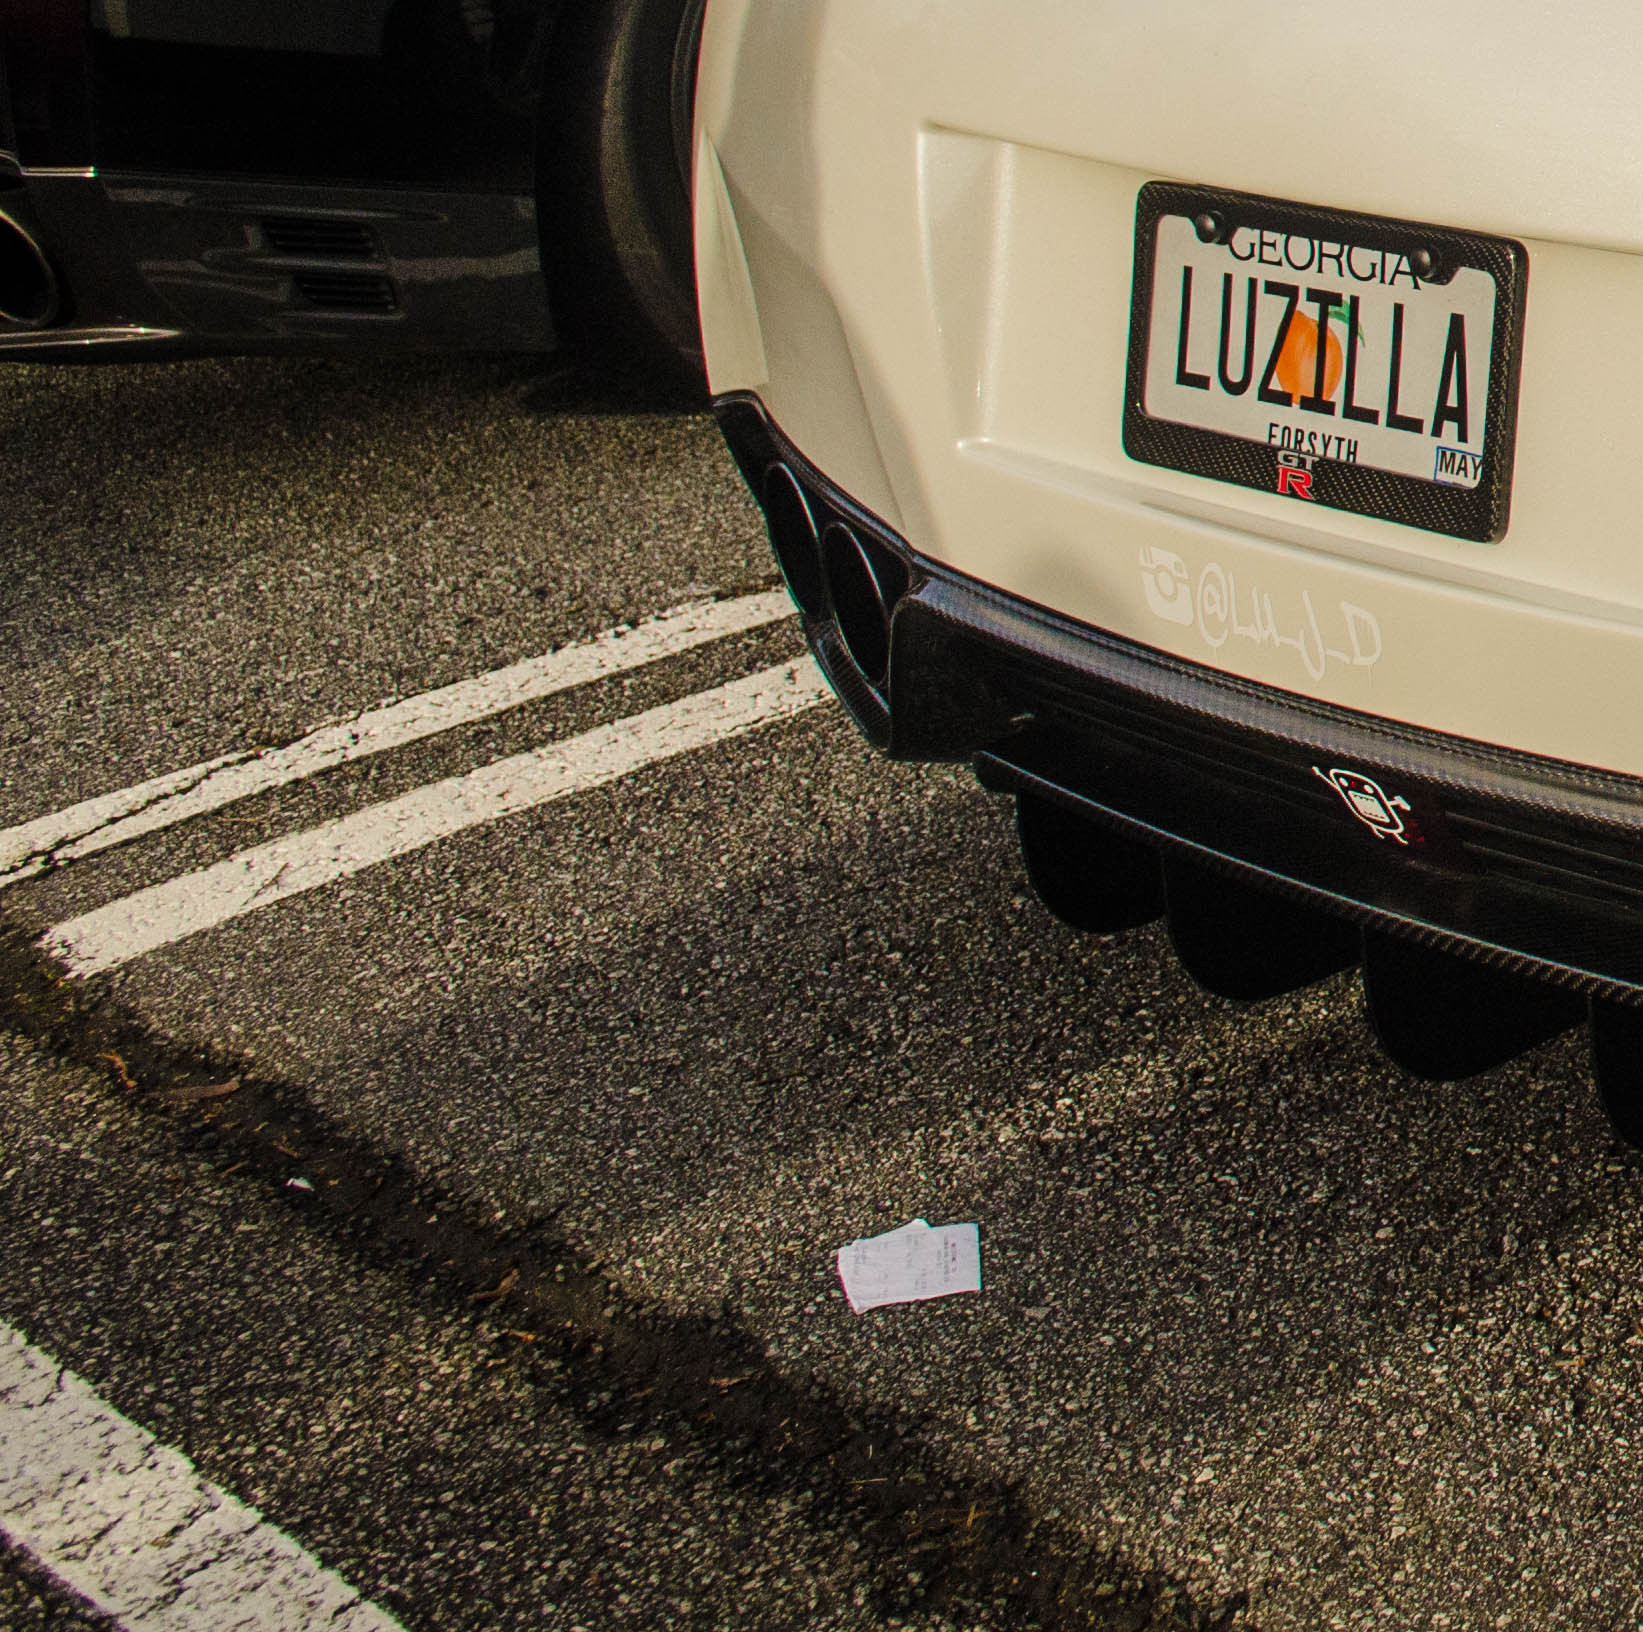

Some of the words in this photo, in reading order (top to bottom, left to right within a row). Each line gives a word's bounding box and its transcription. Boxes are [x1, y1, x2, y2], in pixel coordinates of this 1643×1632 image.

[1229, 226, 1421, 290] GEORGIA
[1175, 264, 1468, 444] LUZILLA
[1268, 422, 1359, 465] FORSYTH
[1439, 450, 1484, 481] MAY
